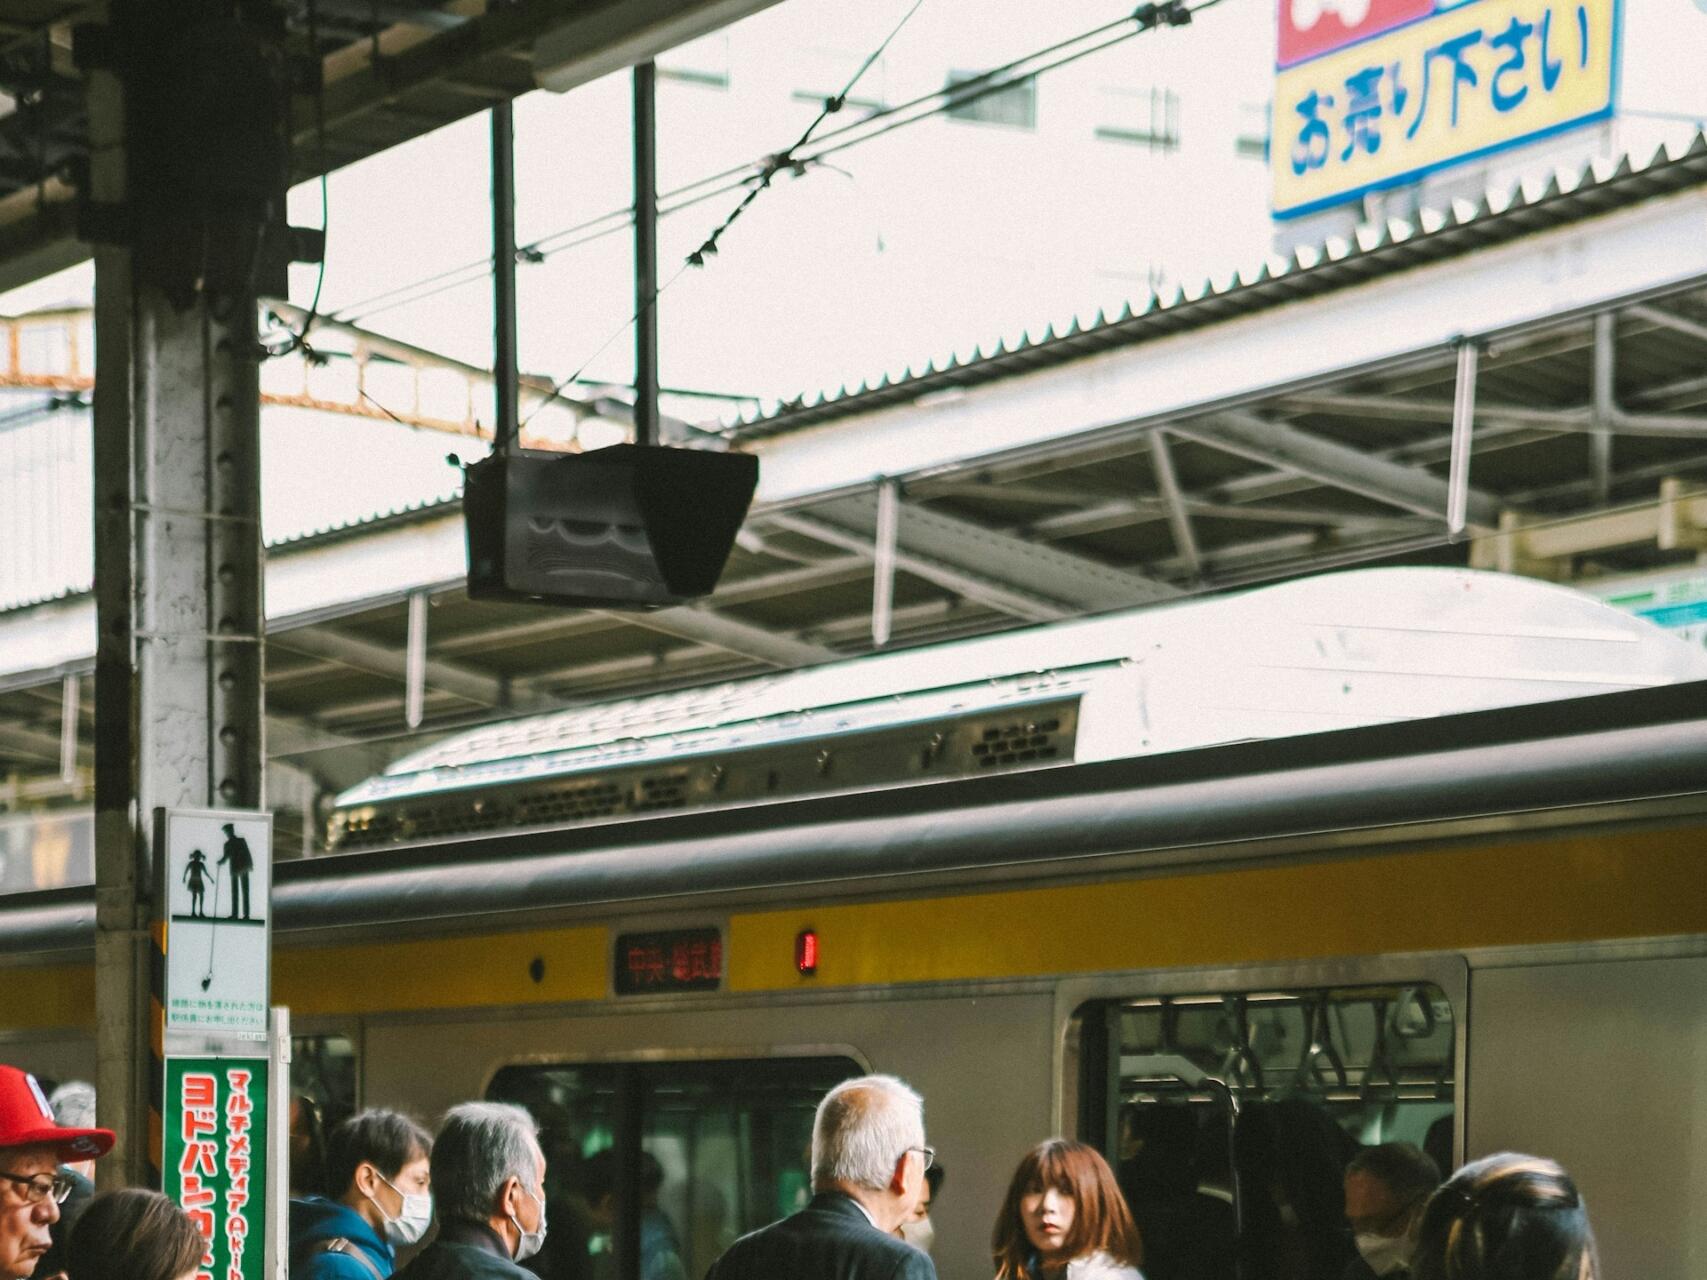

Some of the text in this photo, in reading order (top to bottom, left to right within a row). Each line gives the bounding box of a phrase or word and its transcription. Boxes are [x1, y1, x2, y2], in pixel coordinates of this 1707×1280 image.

[1291, 5, 1588, 175] お売り下さい
